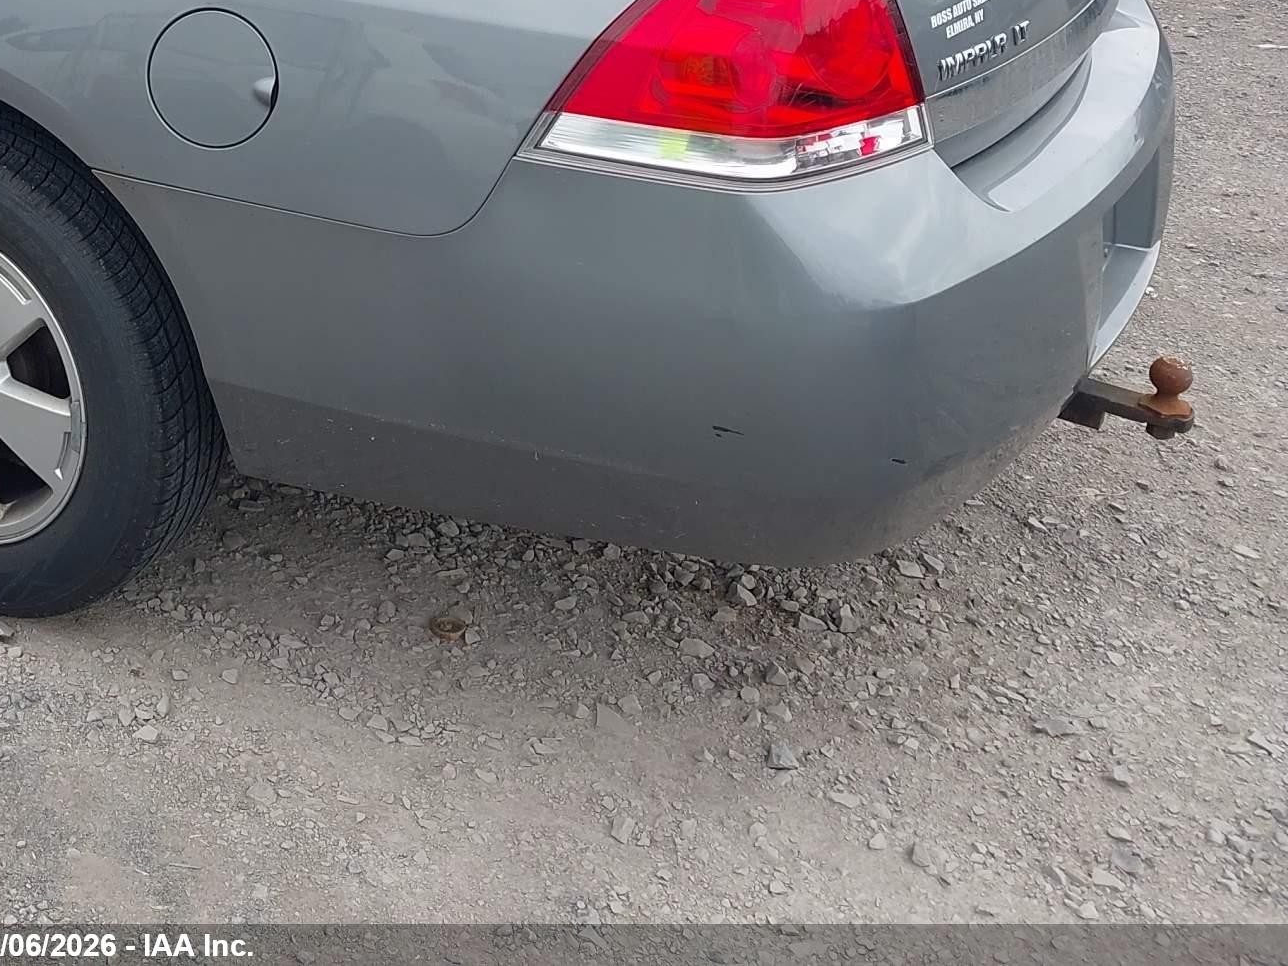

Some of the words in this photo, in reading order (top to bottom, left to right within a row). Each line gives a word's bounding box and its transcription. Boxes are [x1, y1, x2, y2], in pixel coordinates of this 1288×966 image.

[974, 8, 984, 24] NY
[937, 32, 1007, 81] IMPALA
[1011, 20, 1030, 46] LT
